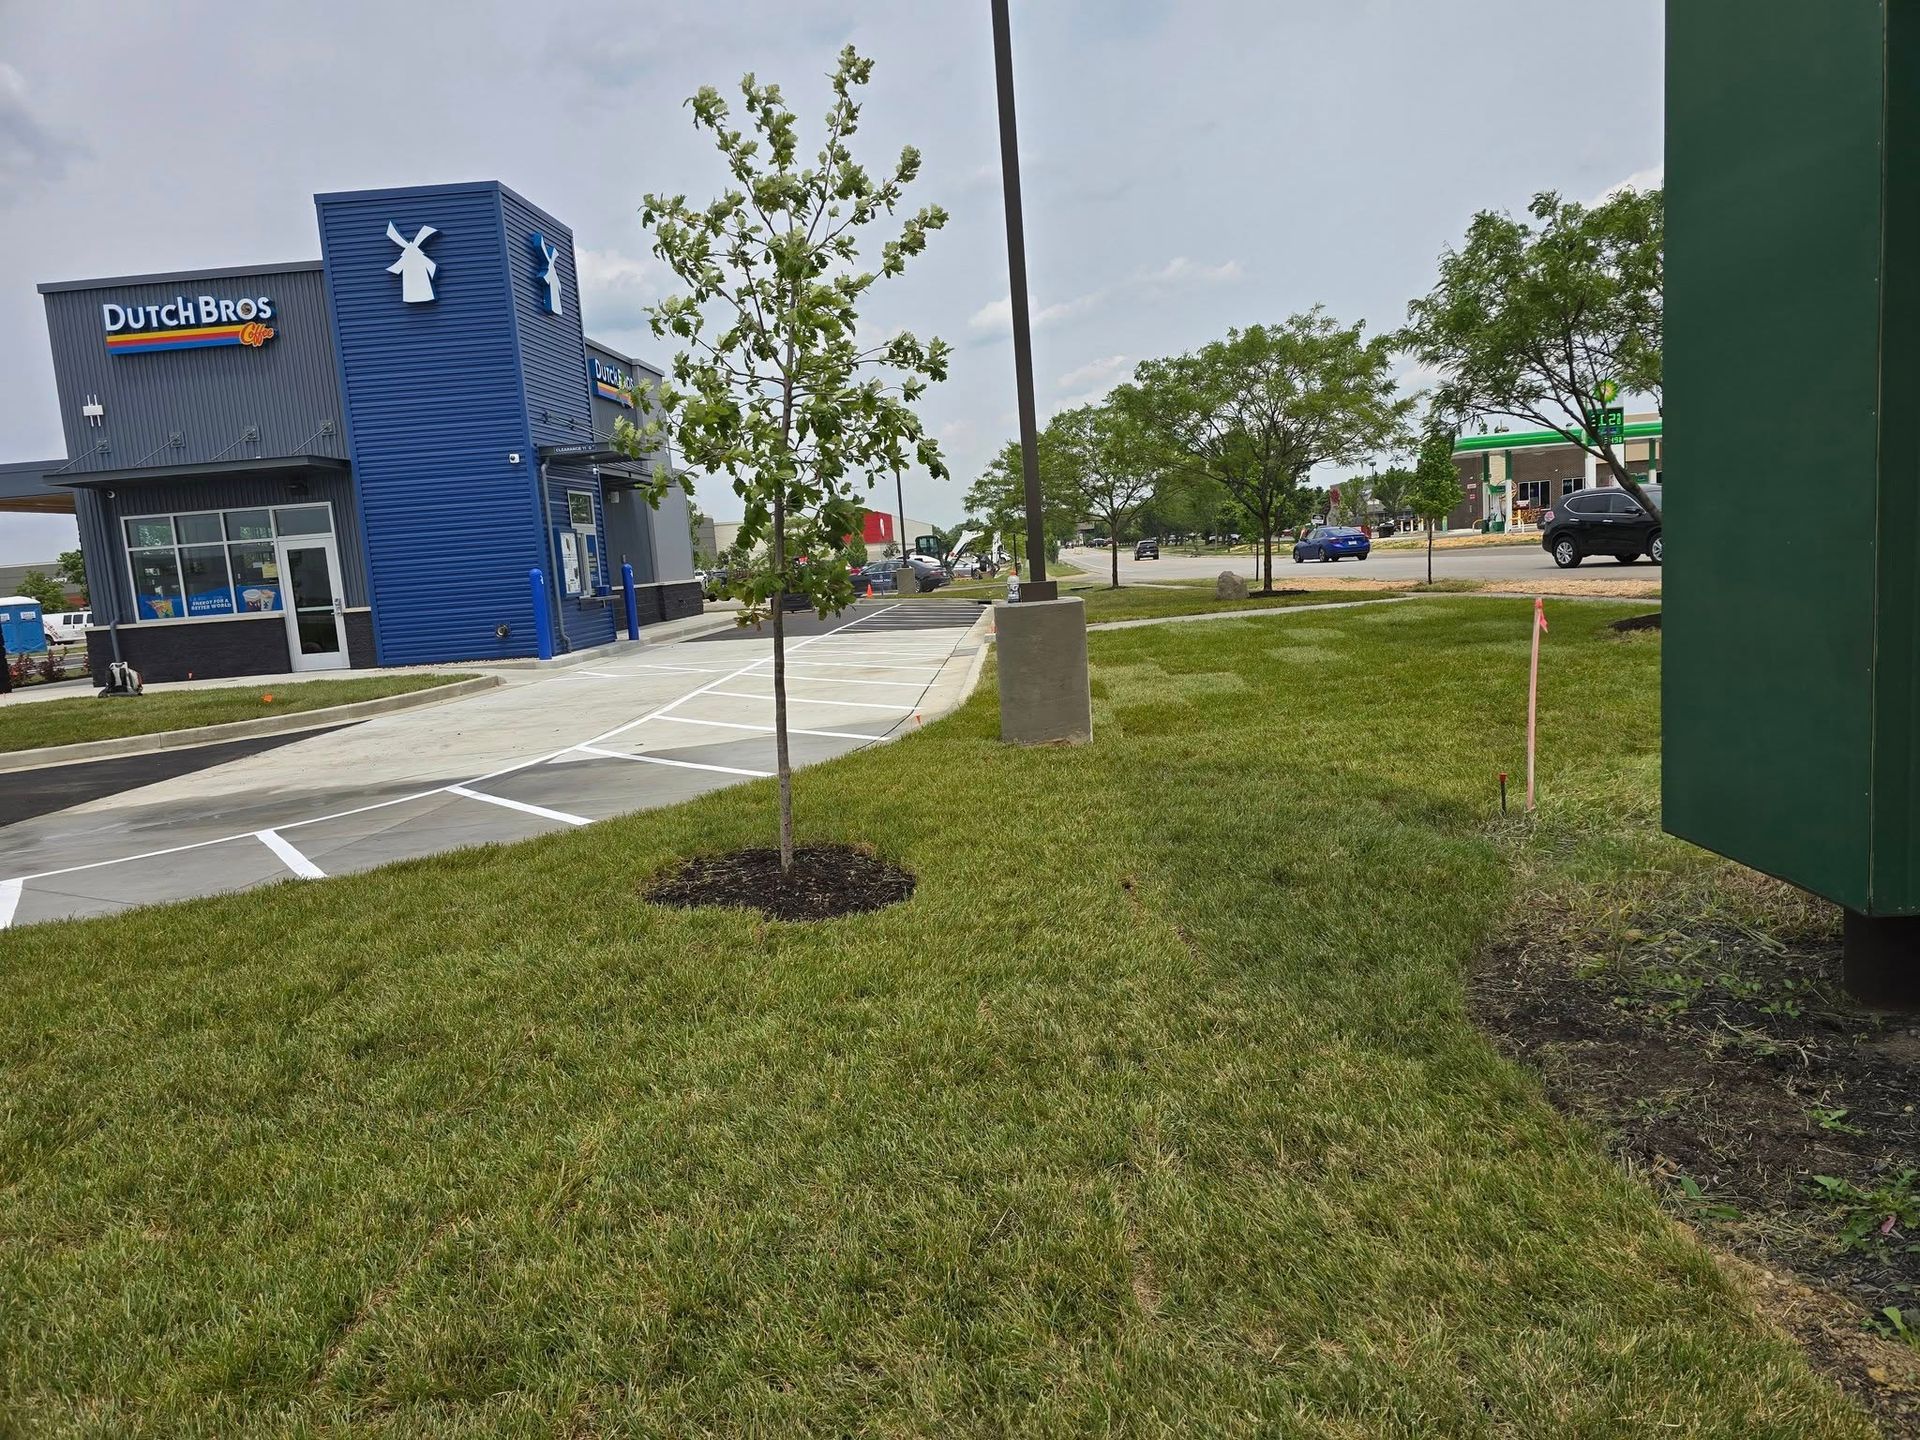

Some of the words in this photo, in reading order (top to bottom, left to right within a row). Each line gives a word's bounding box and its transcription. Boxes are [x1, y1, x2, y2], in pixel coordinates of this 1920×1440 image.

[103, 296, 195, 331] DUTCH
[199, 296, 272, 323] BROS
[239, 322, 273, 347] Coffee
